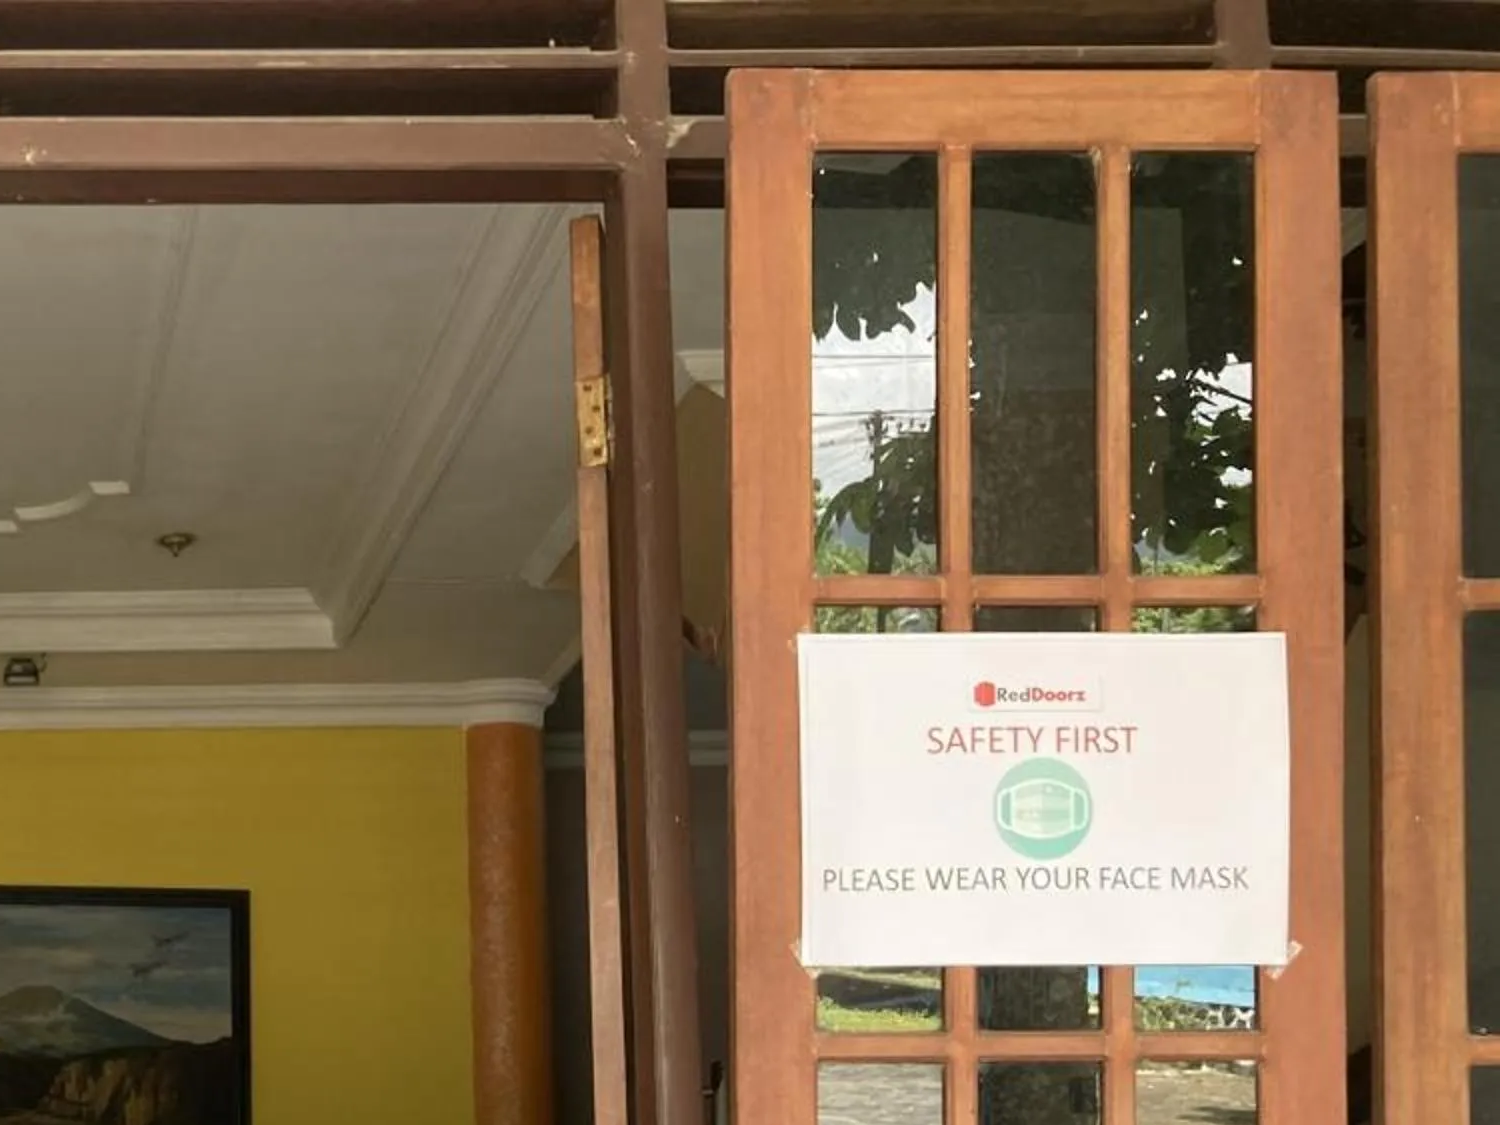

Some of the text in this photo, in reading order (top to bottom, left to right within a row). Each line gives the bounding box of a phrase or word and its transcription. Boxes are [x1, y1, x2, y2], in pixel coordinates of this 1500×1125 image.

[996, 686, 1087, 703] RedDoorz
[926, 725, 1139, 755] SAFETY FIRST
[822, 865, 1250, 892] PLEASE WEAR YOUR FACE MASK
